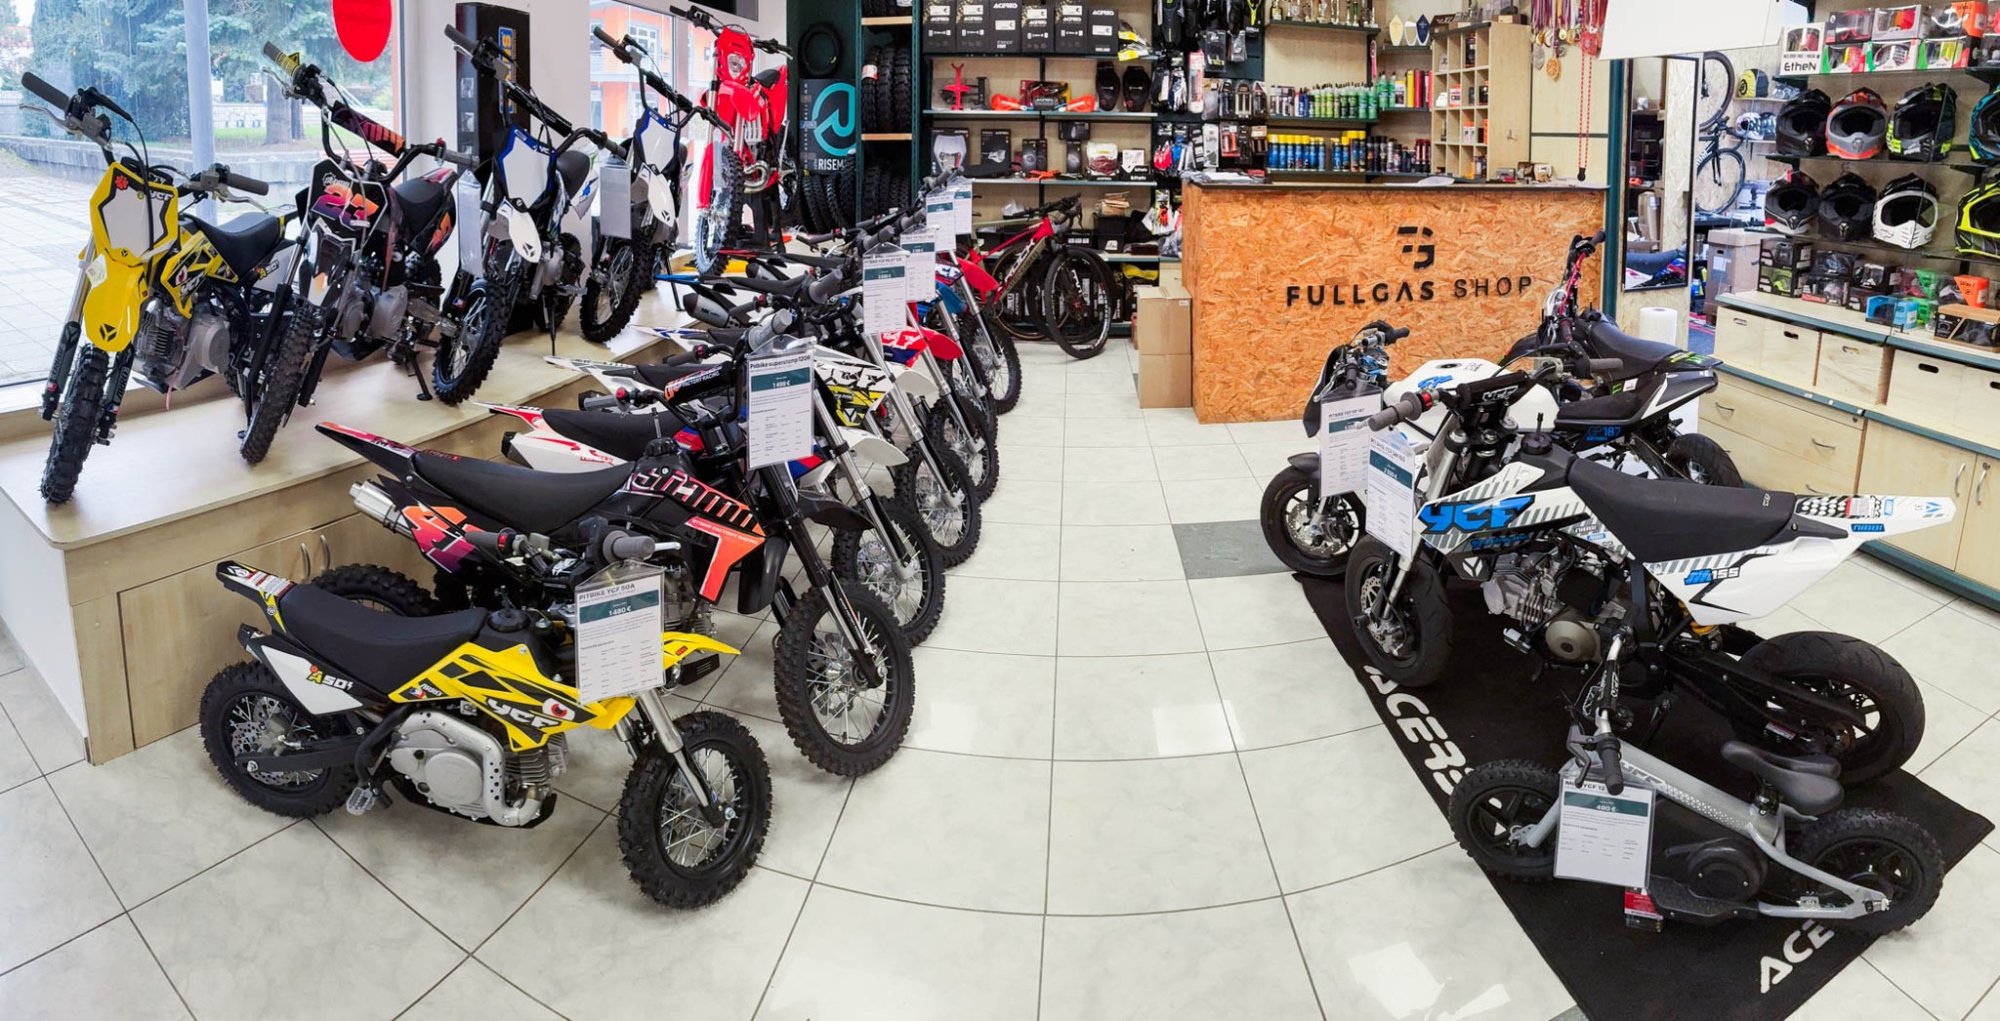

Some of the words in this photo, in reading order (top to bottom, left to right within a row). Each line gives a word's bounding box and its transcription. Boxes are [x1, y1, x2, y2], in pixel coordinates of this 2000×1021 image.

[1286, 280, 1435, 307] FULLGAS
[1453, 275, 1533, 298] SHOP
[1418, 494, 1535, 534] YCF
[579, 590, 605, 601] PITBIKE
[607, 585, 621, 595] YCF
[487, 698, 562, 729] YCF
